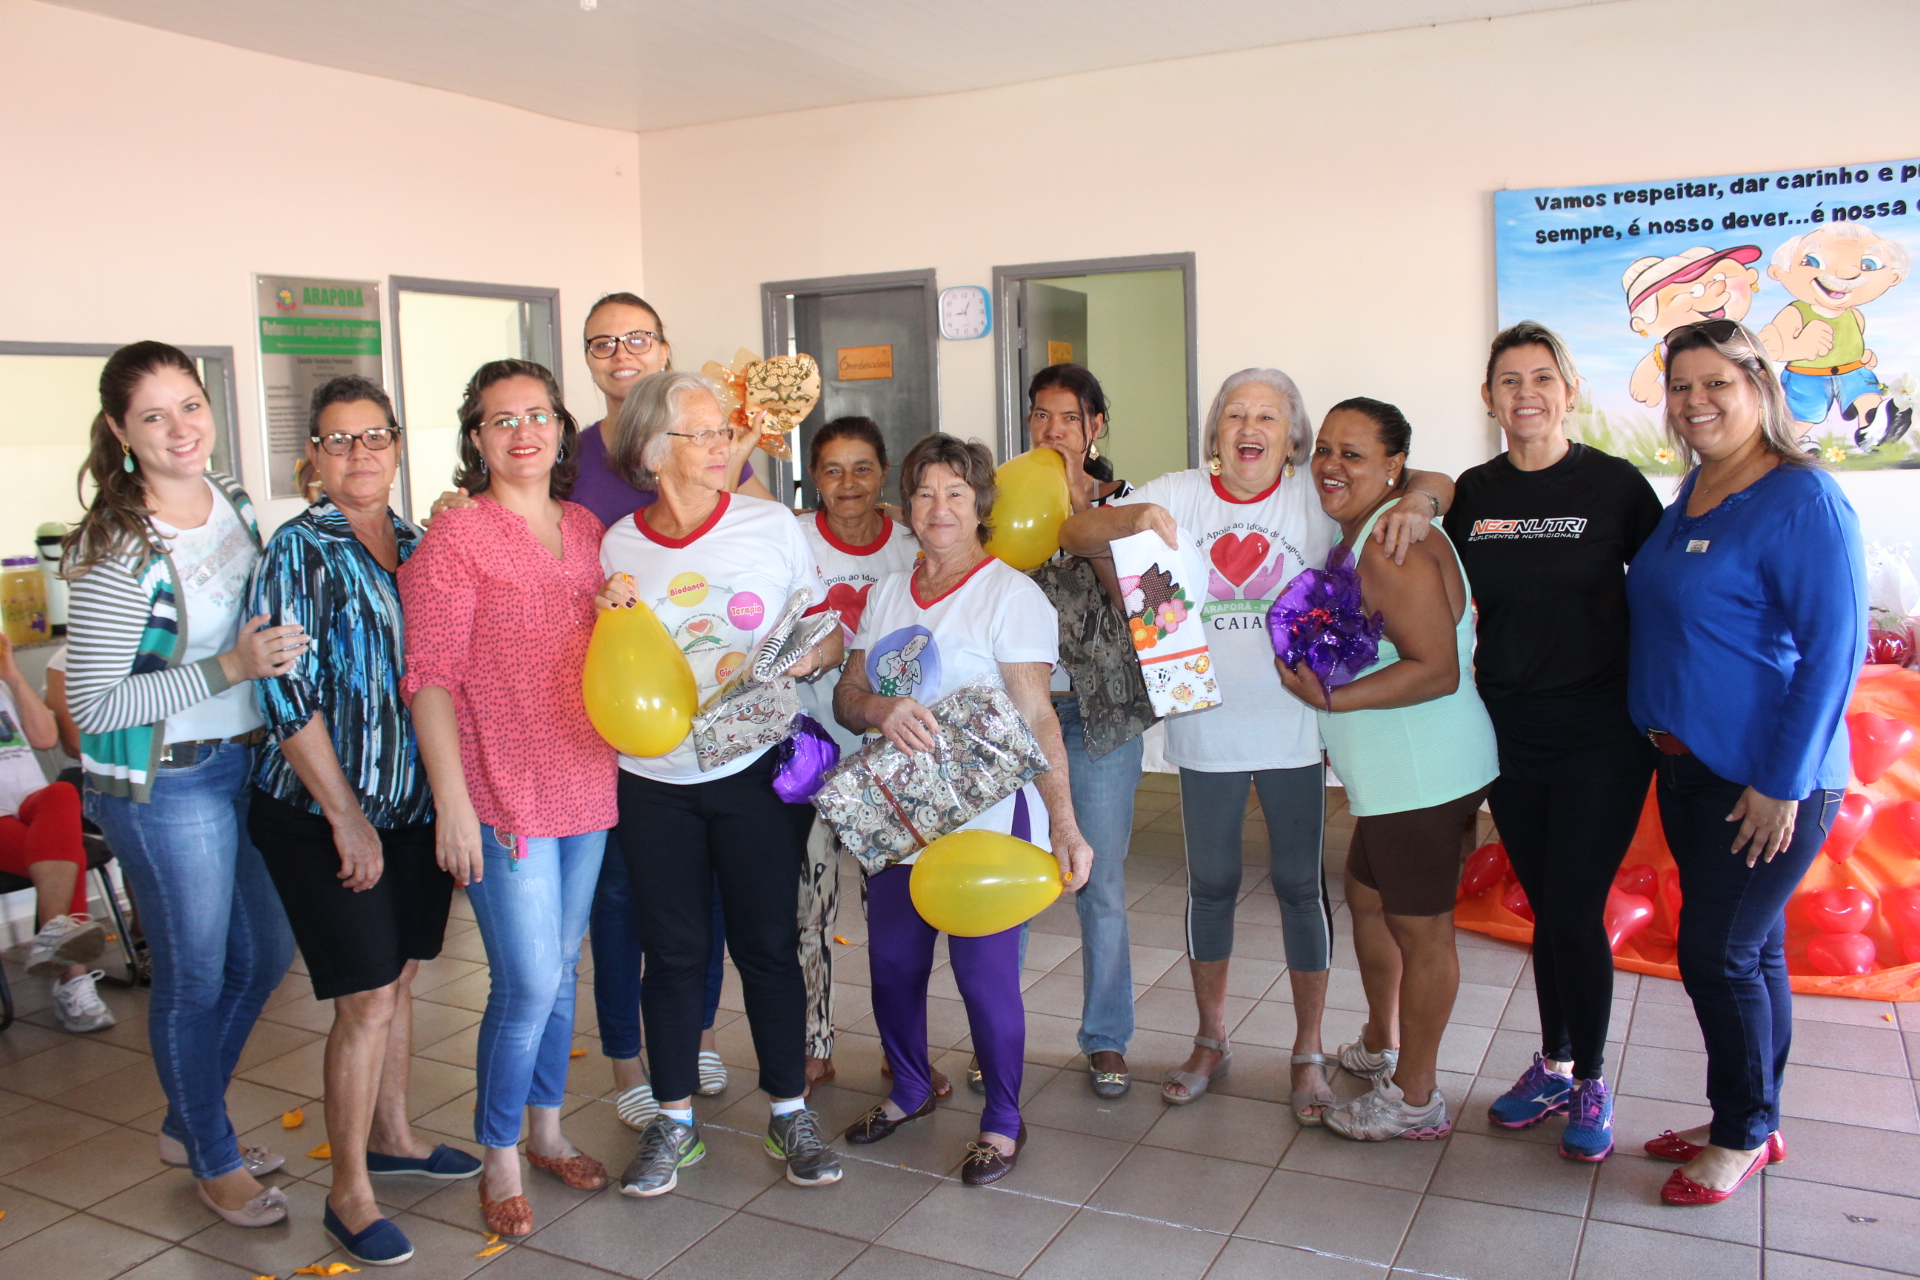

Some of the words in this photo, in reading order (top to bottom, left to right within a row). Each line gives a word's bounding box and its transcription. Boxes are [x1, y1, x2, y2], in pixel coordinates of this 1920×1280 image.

[1535, 193, 1607, 211] Vamos
[1612, 181, 1724, 207] respeitar,
[1730, 177, 1770, 194] dar
[1777, 167, 1870, 191] carinho
[1880, 167, 1894, 182] e
[1535, 225, 1622, 244] sempre,
[1628, 217, 1641, 236] é
[1648, 218, 1715, 234] nosso
[1833, 199, 1907, 221] nossa
[302, 286, 365, 307] ARAPORÃ
[1470, 516, 1588, 537] NEONUTRI
[1195, 537, 1205, 549] de
[1206, 524, 1231, 541] Apoio
[1232, 522, 1244, 530] ao
[1246, 522, 1269, 535] Idoso
[1521, 530, 1581, 540] NUTRICIONAIS
[848, 573, 860, 581] ao
[670, 581, 705, 597] Biodança
[731, 602, 763, 616] Terapia
[1203, 601, 1251, 614] ARAPORÃ
[1213, 616, 1263, 631] CAIA
